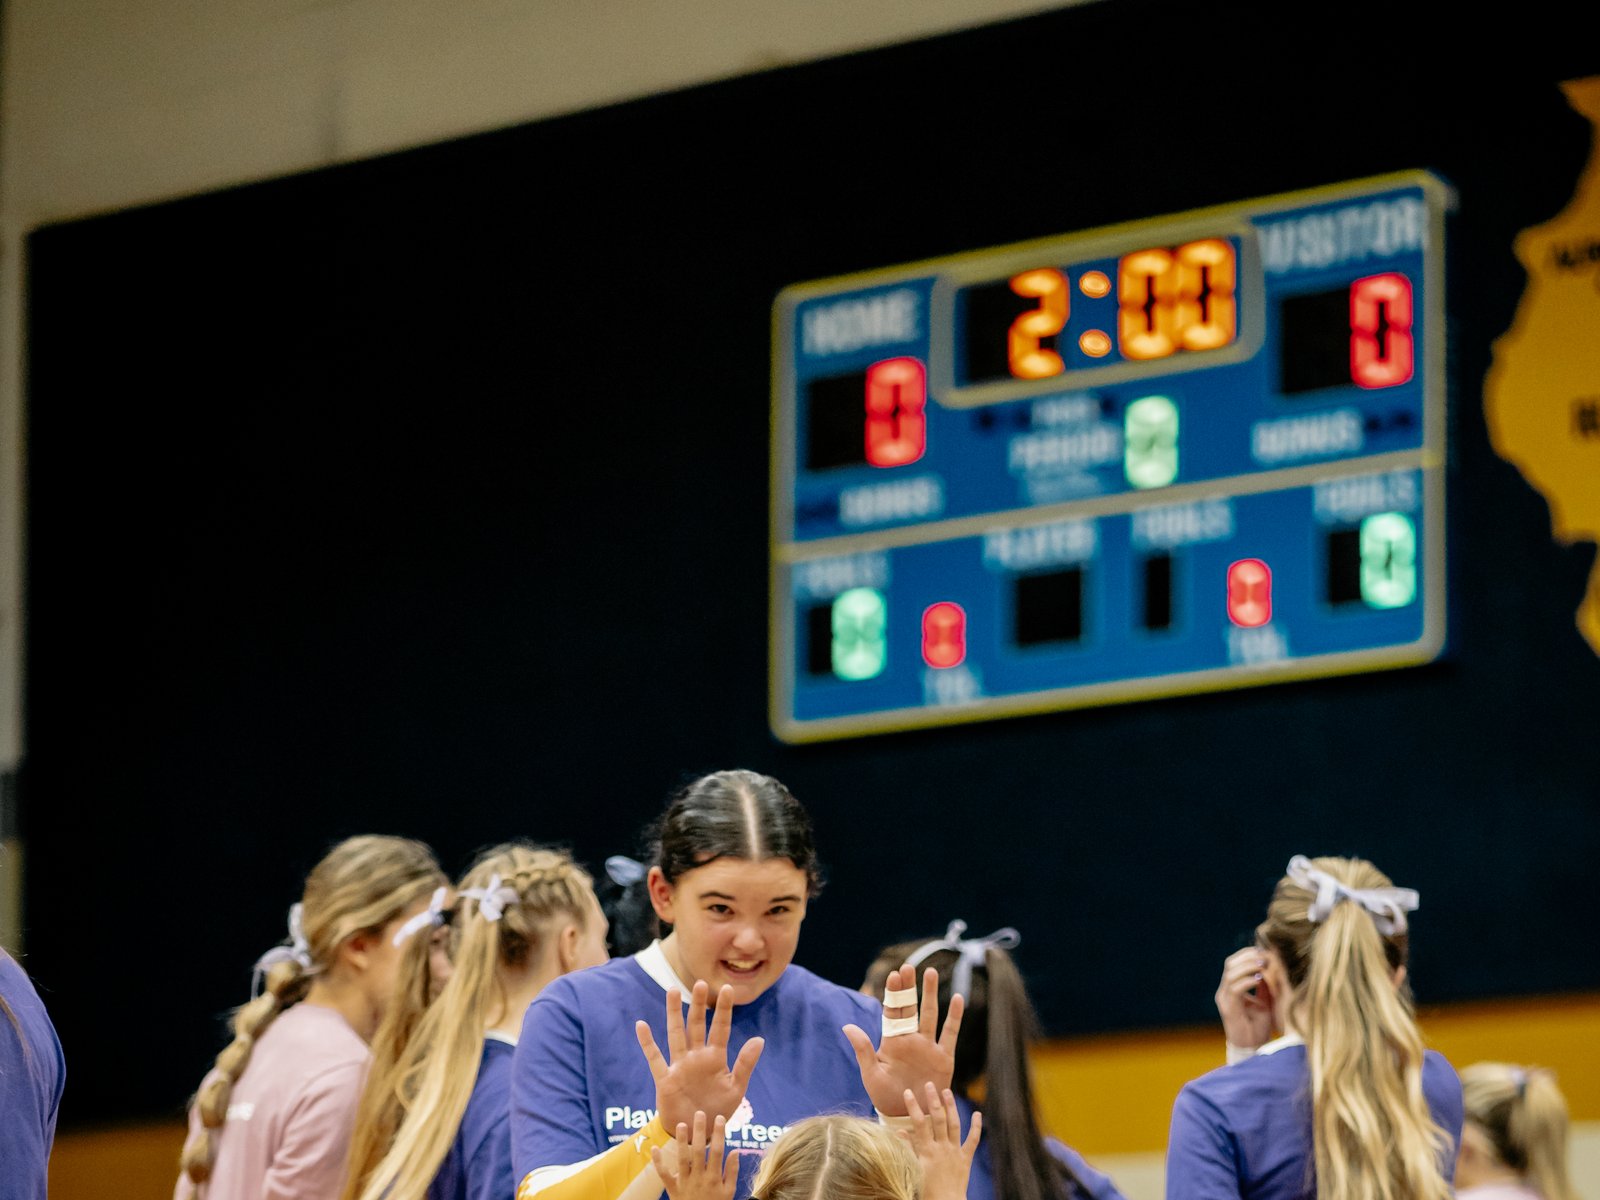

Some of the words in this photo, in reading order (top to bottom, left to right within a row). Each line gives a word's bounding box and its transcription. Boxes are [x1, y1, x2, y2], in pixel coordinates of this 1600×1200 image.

[1008, 238, 1236, 380] 2:00
[1350, 272, 1414, 389] 0
[865, 356, 926, 468] 0
[724, 1117, 793, 1142] Pree
